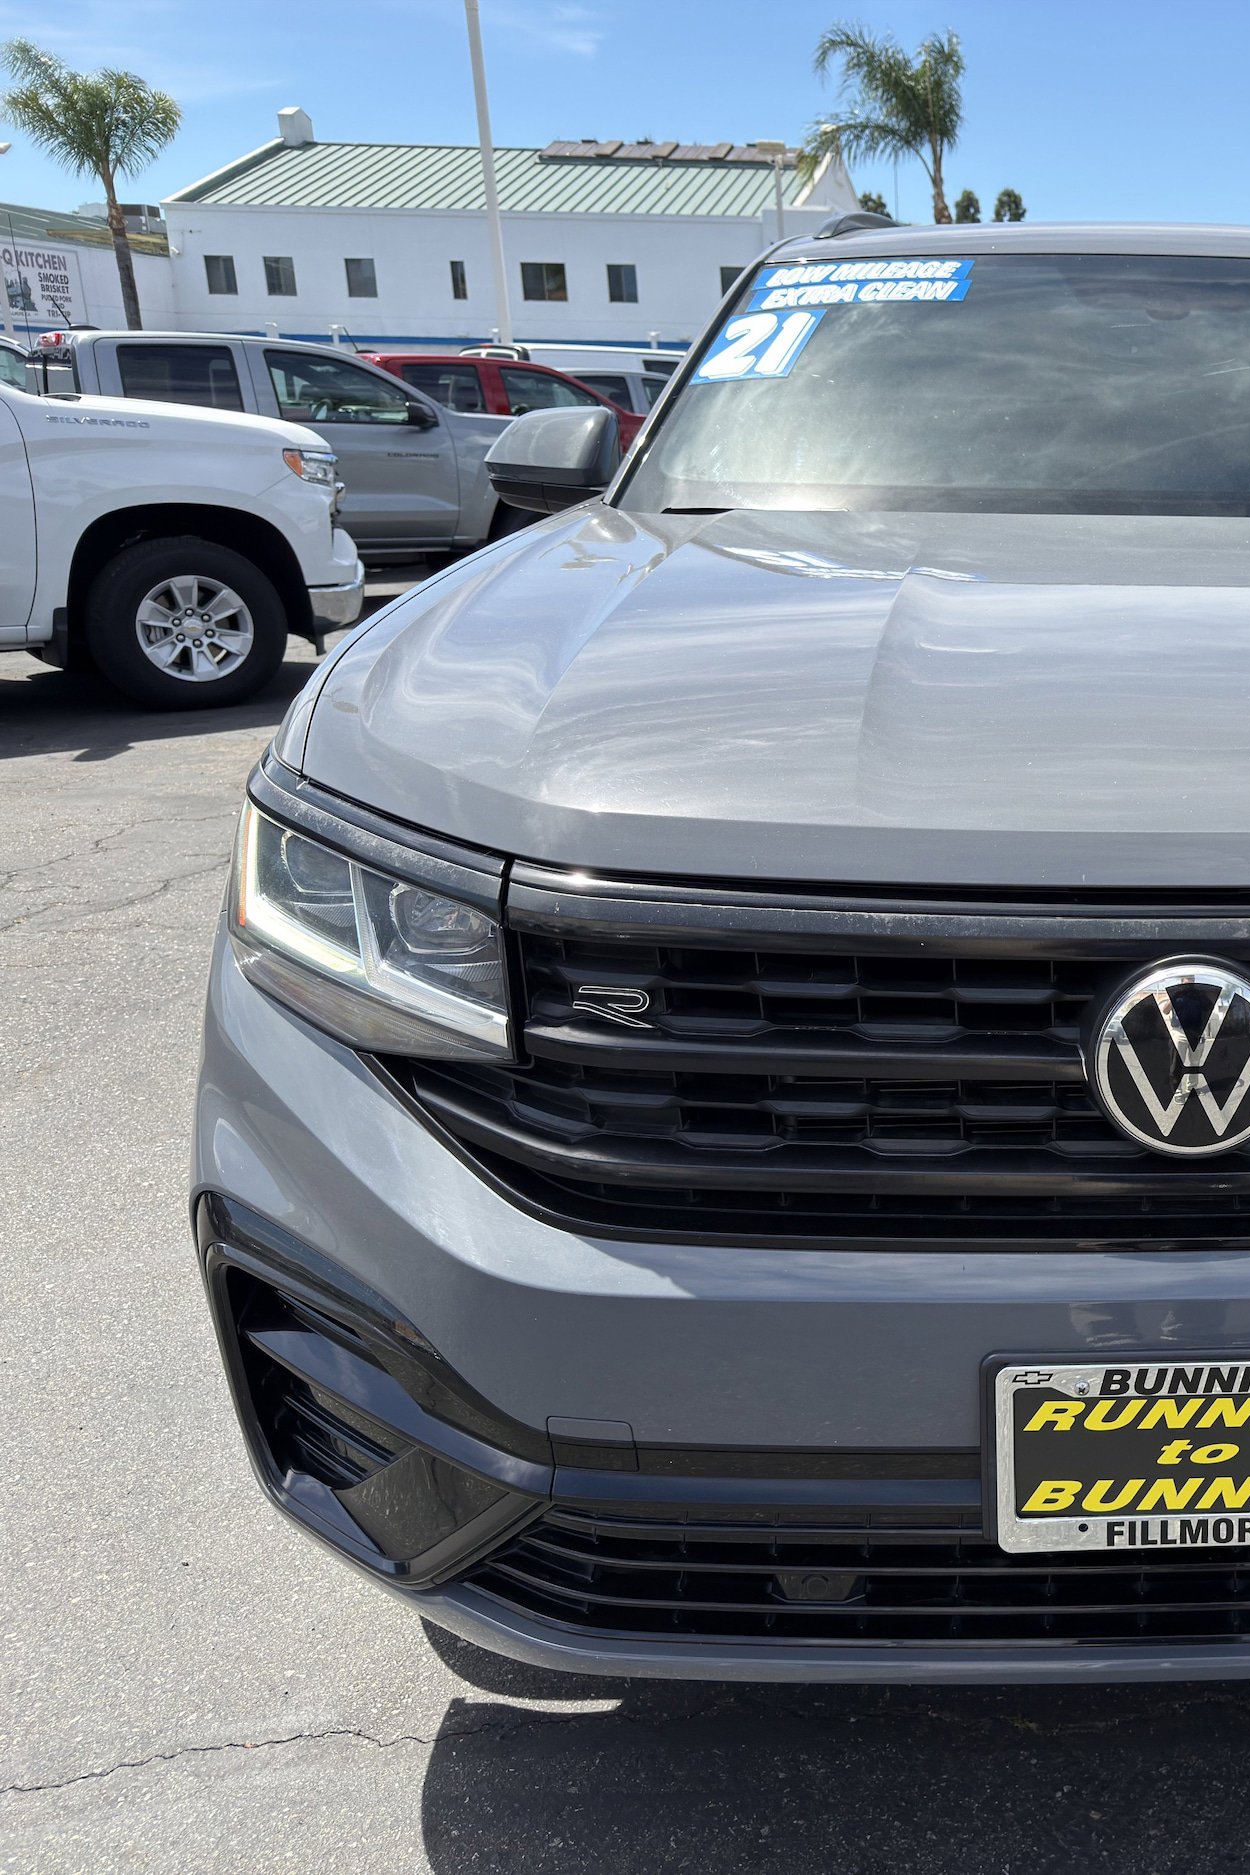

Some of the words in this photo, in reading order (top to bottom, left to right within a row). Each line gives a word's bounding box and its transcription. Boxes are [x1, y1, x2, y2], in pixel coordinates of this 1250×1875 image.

[15, 250, 67, 271] KITCHEN
[38, 271, 69, 285] SMOKED
[765, 264, 832, 288] LOW
[829, 260, 962, 282] MILEAGE
[40, 284, 70, 294] BRISKET
[41, 293, 59, 302] PULED
[760, 283, 857, 309] EXTRA
[858, 280, 959, 302] CLEAN
[52, 302, 65, 310] AD
[699, 311, 816, 380] 21
[46, 414, 150, 429] SILVERADO
[1156, 1439, 1240, 1465] to
